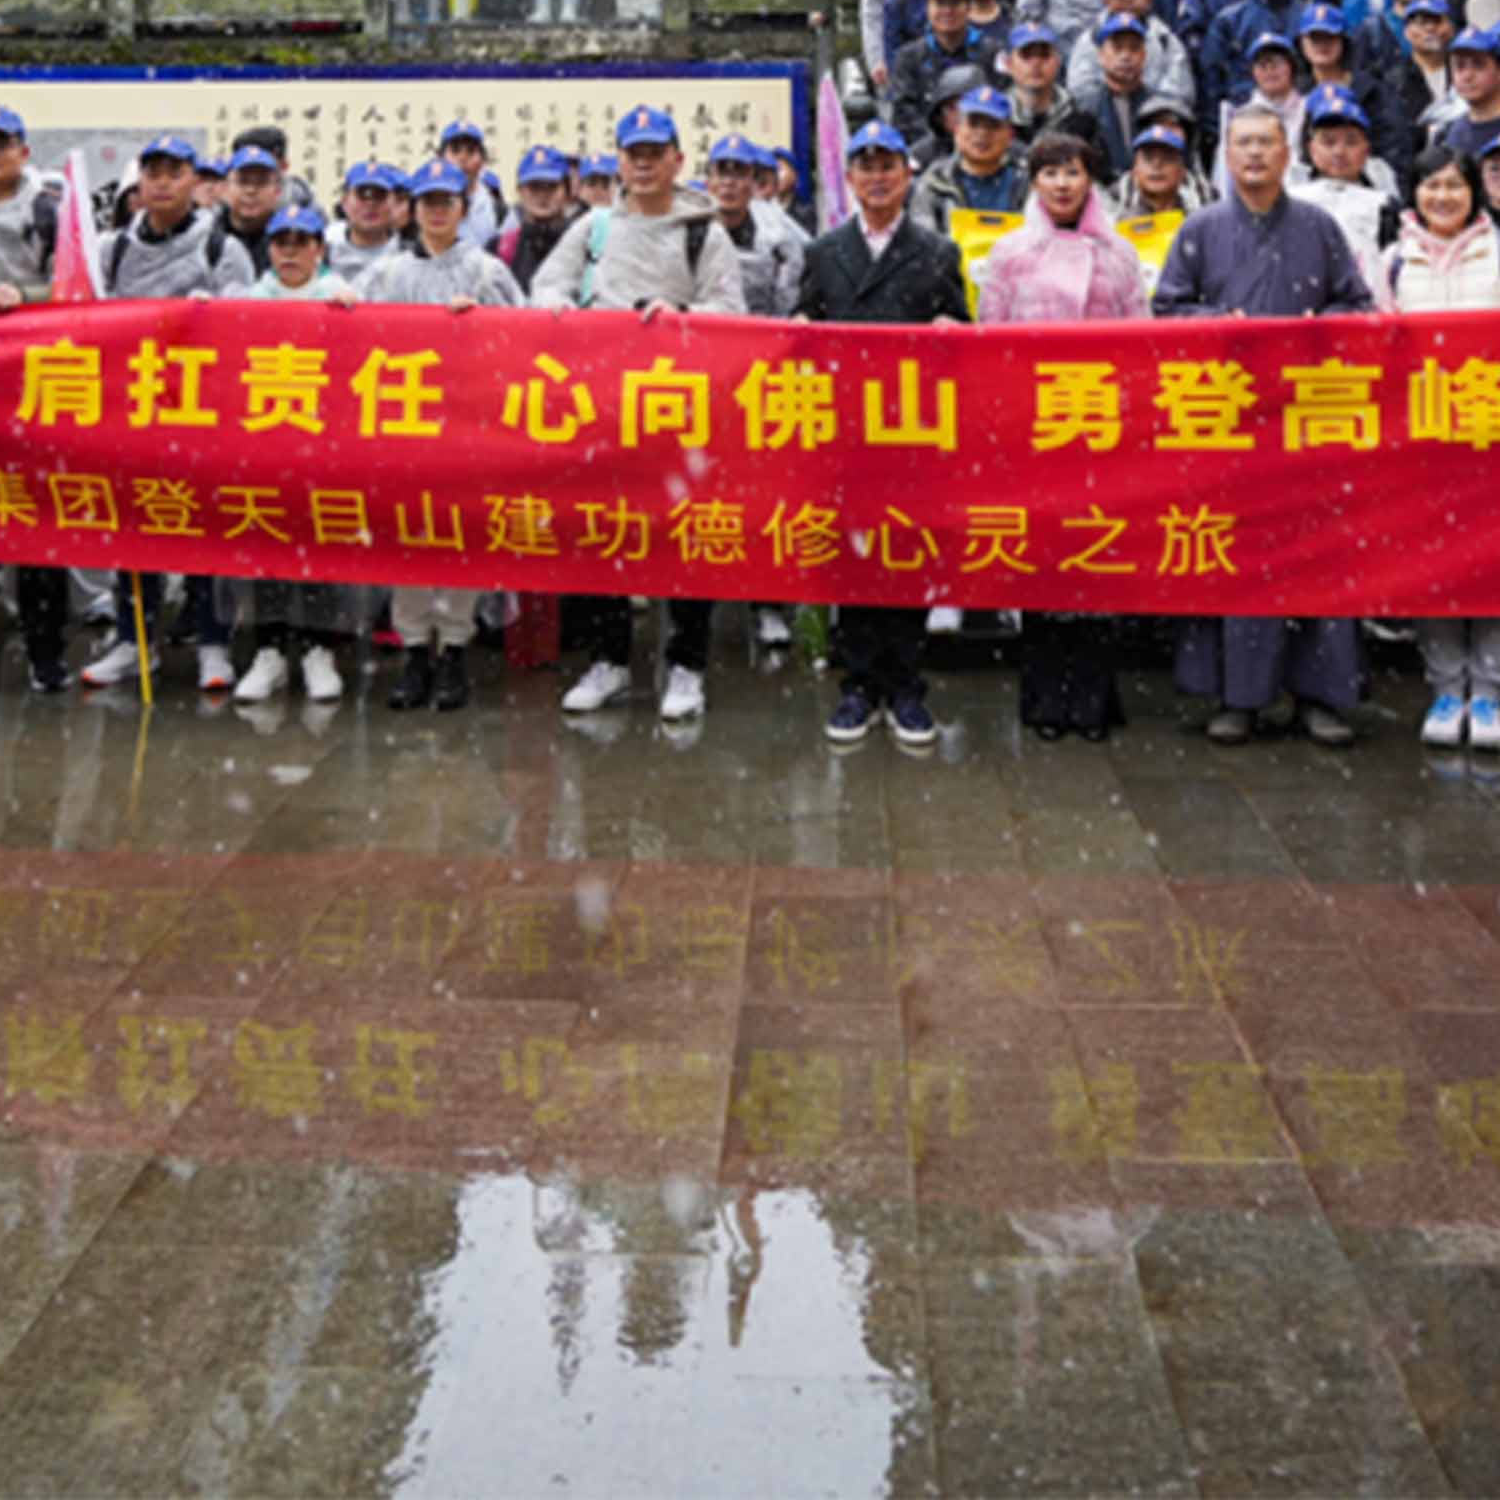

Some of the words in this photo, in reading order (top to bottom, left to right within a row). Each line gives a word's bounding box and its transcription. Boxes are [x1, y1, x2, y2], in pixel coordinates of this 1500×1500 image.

[16, 336, 444, 439] 肩扛责任
[500, 353, 959, 453] 心向佛山
